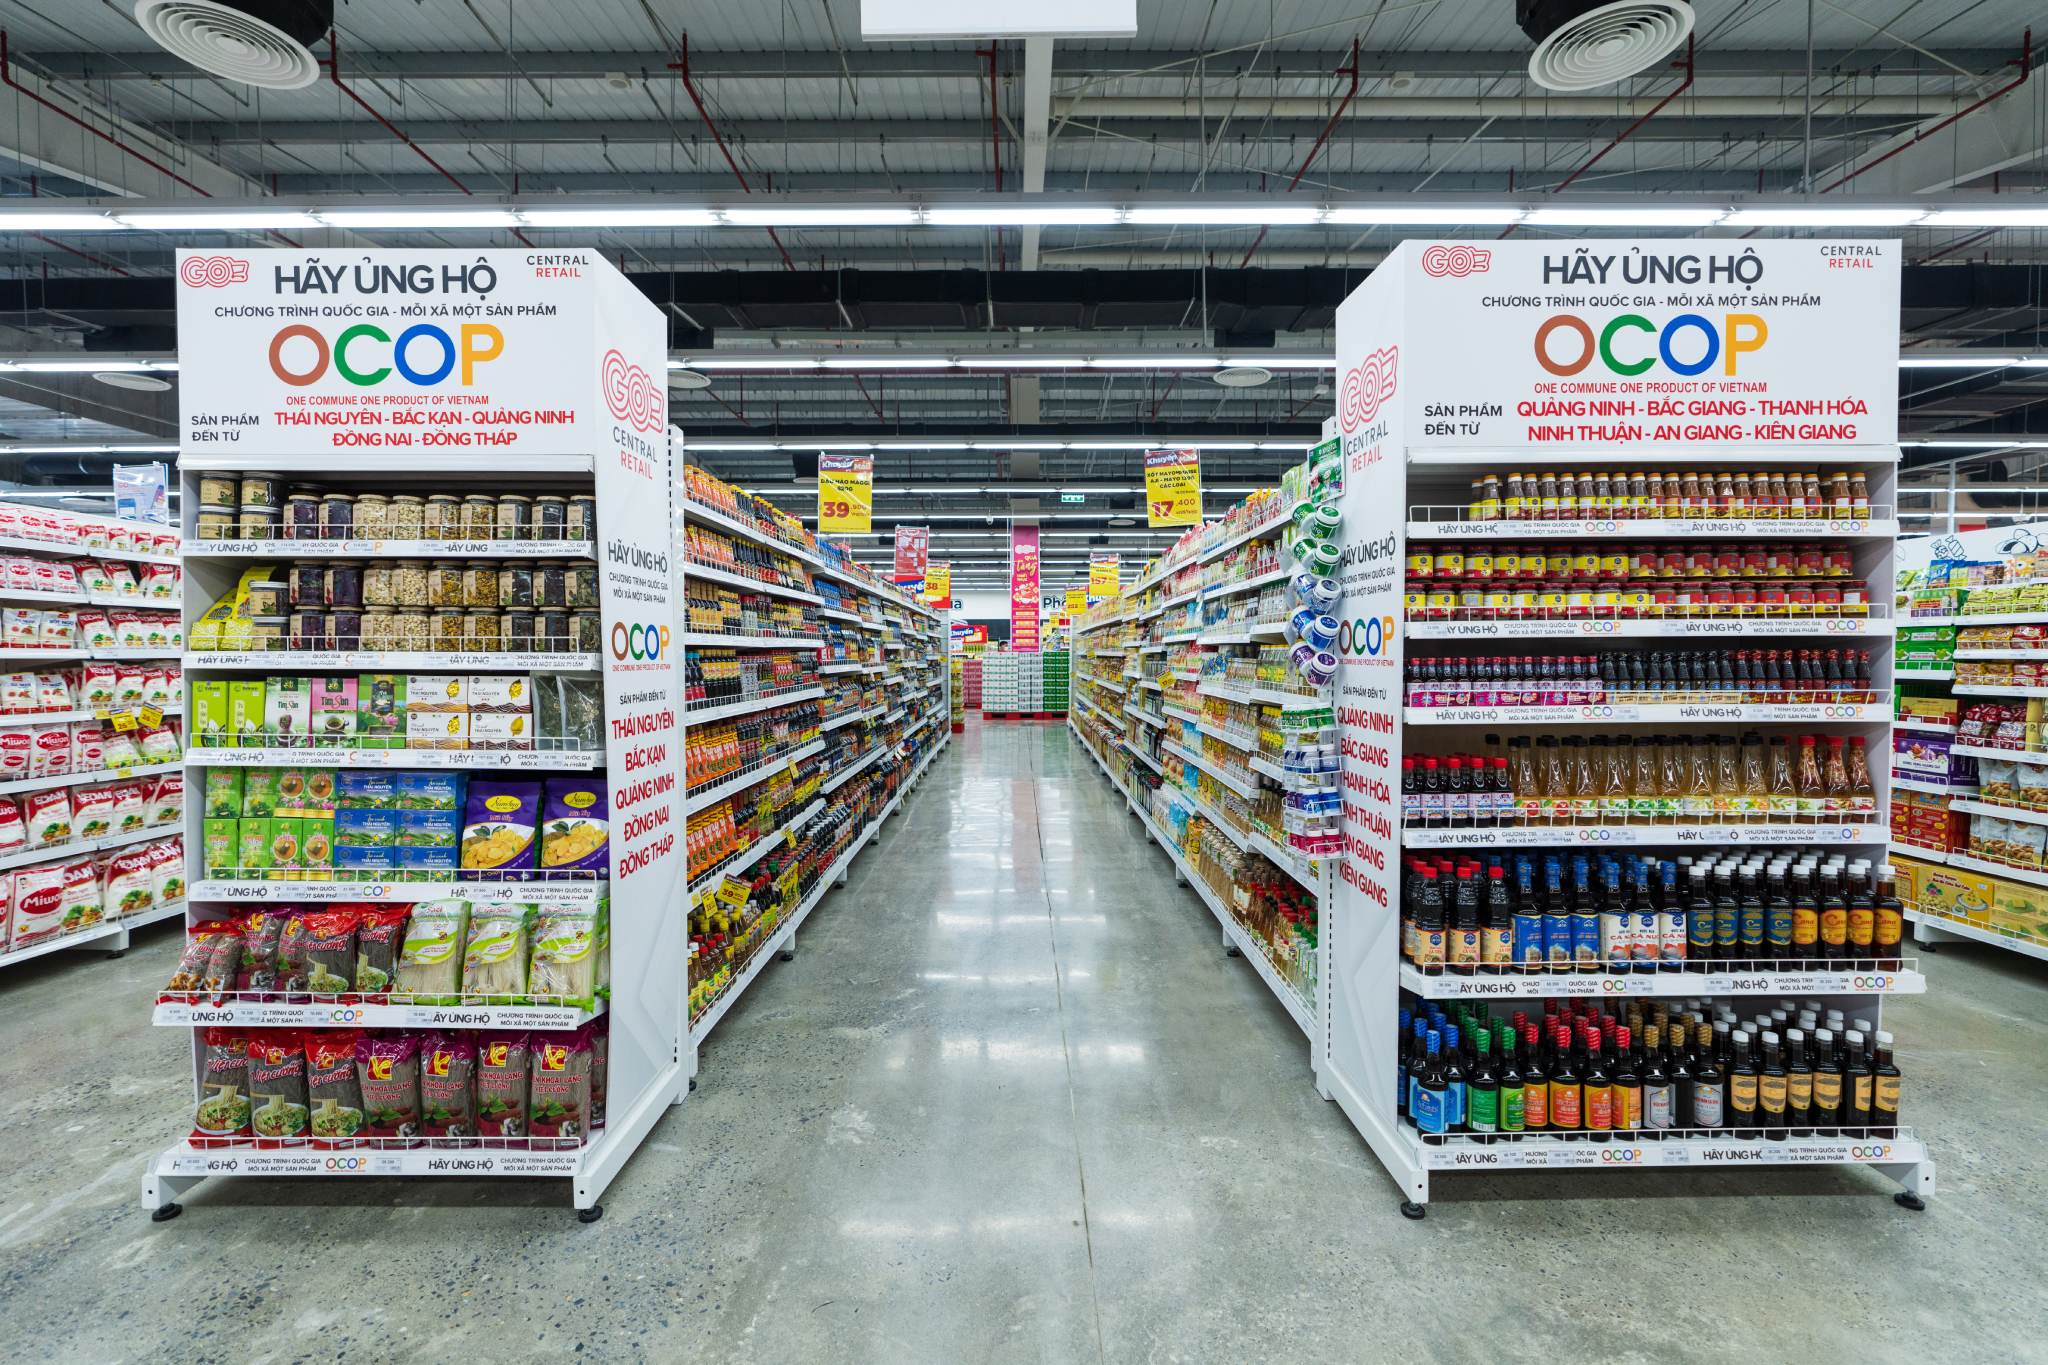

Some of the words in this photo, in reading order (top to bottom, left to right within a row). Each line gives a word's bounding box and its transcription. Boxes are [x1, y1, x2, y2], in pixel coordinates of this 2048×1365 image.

[1821, 246, 1882, 256] CENTRAL
[527, 256, 589, 266] CENTRAL
[1544, 248, 1616, 284] HÃY
[1623, 247, 1701, 284] ỦNG
[1709, 247, 1764, 291] HỘ
[1829, 259, 1874, 269] RETAIL
[275, 258, 347, 294] HÃY
[355, 256, 434, 294] ỦNG
[442, 257, 497, 301] HỘ
[535, 268, 582, 278] RETAIL
[1482, 296, 1541, 307] CHƯƠNG
[1545, 296, 1585, 307] TRÌNH
[1589, 294, 1629, 307] QUỐC
[1632, 296, 1656, 307] GIA
[1667, 293, 1693, 306] MỖI
[1696, 294, 1715, 306] XÃ
[1719, 294, 1748, 308] MỘT
[1751, 294, 1778, 306] SẢN
[1783, 294, 1821, 306] PHẨM
[215, 305, 275, 317] CHƯƠNG
[278, 304, 319, 316] TRÌNH
[323, 304, 363, 317] QUỐC
[366, 306, 390, 316] GIA
[400, 303, 427, 316] MỖI
[430, 304, 449, 316] XÃ
[453, 304, 483, 318] MỘT
[486, 303, 513, 316] SẢN
[518, 303, 557, 316] PHẨM
[1535, 314, 1768, 377] OCOP
[269, 324, 504, 387] OCOP
[1535, 383, 1558, 394] ONE
[1561, 383, 1617, 393] COMMUNE
[1620, 383, 1643, 393] ONE
[1646, 383, 1699, 393] PRODUCT
[1702, 383, 1716, 393] OF
[1719, 383, 1768, 393] VIETNAM
[286, 395, 306, 405] ONE
[309, 395, 357, 405] COMMUNE
[360, 395, 381, 405] ONE
[384, 395, 429, 405] PRODUCT
[432, 395, 445, 405] OF
[447, 395, 489, 405] VIETNAM
[1517, 397, 1585, 417] QUẢNG
[1590, 401, 1635, 417] NINH
[1648, 396, 1684, 416] BẮC
[1688, 400, 1747, 417] GIANG
[1758, 400, 1823, 416] THANH
[1827, 396, 1868, 416] HÓA
[274, 409, 311, 425] THÁI
[314, 408, 382, 425] NGUYÊN
[393, 407, 425, 425] BẮC
[429, 411, 463, 428] KẠN
[472, 409, 532, 425] QUẢNG
[535, 410, 575, 425] NINH
[1424, 402, 1455, 417] SẢN
[1459, 402, 1503, 417] PHẨM
[191, 413, 218, 426] SẢN
[222, 413, 260, 426] PHẨM
[1424, 420, 1456, 435] ĐẾN
[1460, 419, 1482, 435] TỪ
[191, 429, 219, 442] ĐẾN
[222, 429, 241, 442] TỪ
[333, 429, 383, 446] ĐỒNG
[385, 432, 412, 446] NAI
[422, 429, 471, 446] ĐỒNG
[474, 429, 518, 446] THÁP
[1346, 420, 1389, 456] CENTRAL
[1529, 425, 1573, 442] NINH
[1577, 421, 1641, 444] THUẬN
[1645, 424, 1681, 441] AN
[1684, 424, 1743, 441] GIANG
[1755, 420, 1794, 440] KIÊN
[1798, 423, 1857, 440] GIANG
[613, 426, 658, 463] CENTRAL
[620, 450, 653, 480] RETAIL
[1352, 445, 1383, 473] RETAIL
[823, 502, 850, 518] 39
[1152, 501, 1174, 517] 17
[1585, 521, 1624, 531] OCOP
[1830, 521, 1868, 531] OCOP
[1340, 545, 1357, 568] HÃY
[1358, 540, 1379, 564] ỦNG
[1380, 531, 1396, 560] HỘ
[608, 539, 630, 564] HÃY
[632, 542, 653, 568] ỦNG
[654, 552, 668, 578] HỘ
[1582, 621, 1621, 632] OCOP
[611, 621, 670, 661] OCOP
[1338, 616, 1395, 656] OCOP
[620, 691, 632, 704] SẢN
[632, 690, 648, 704] PHẨM
[648, 690, 660, 701] ĐẾN
[660, 689, 666, 700] TỪ
[1338, 703, 1369, 730] QUẢNG
[1370, 711, 1394, 735] NINH
[1825, 706, 1863, 717] OCOP
[612, 711, 635, 739] THÁI
[637, 707, 674, 735] NGUYÊN
[39, 735, 69, 747] Miwon
[626, 744, 645, 771] BẮC
[647, 744, 666, 768] KẠN
[1341, 733, 1358, 759] BẮC
[1359, 744, 1389, 769] GIANG
[616, 779, 652, 809] QUẢNG
[653, 772, 675, 799] NINH
[1369, 778, 1391, 805] HÓA
[624, 815, 653, 842] ĐỒNG
[655, 805, 669, 829] NAI
[1344, 800, 1358, 824] INH
[1359, 807, 1391, 840] THUẬN
[620, 850, 649, 879] ĐỒNG
[651, 832, 674, 860] THÁP
[1356, 839, 1384, 871] GIANG
[1340, 860, 1358, 888] KIÊN
[1359, 873, 1388, 908] GIANG
[1854, 976, 1894, 989] OCOP
[217, 1009, 234, 1023] HỘ
[1601, 1148, 1642, 1161] OCOP
[1851, 1145, 1892, 1159] OCOP
[326, 1157, 367, 1170] OCOP
[429, 1158, 451, 1169] HÃY
[451, 1159, 477, 1170] ỦNG
[477, 1157, 494, 1171] HỘ
